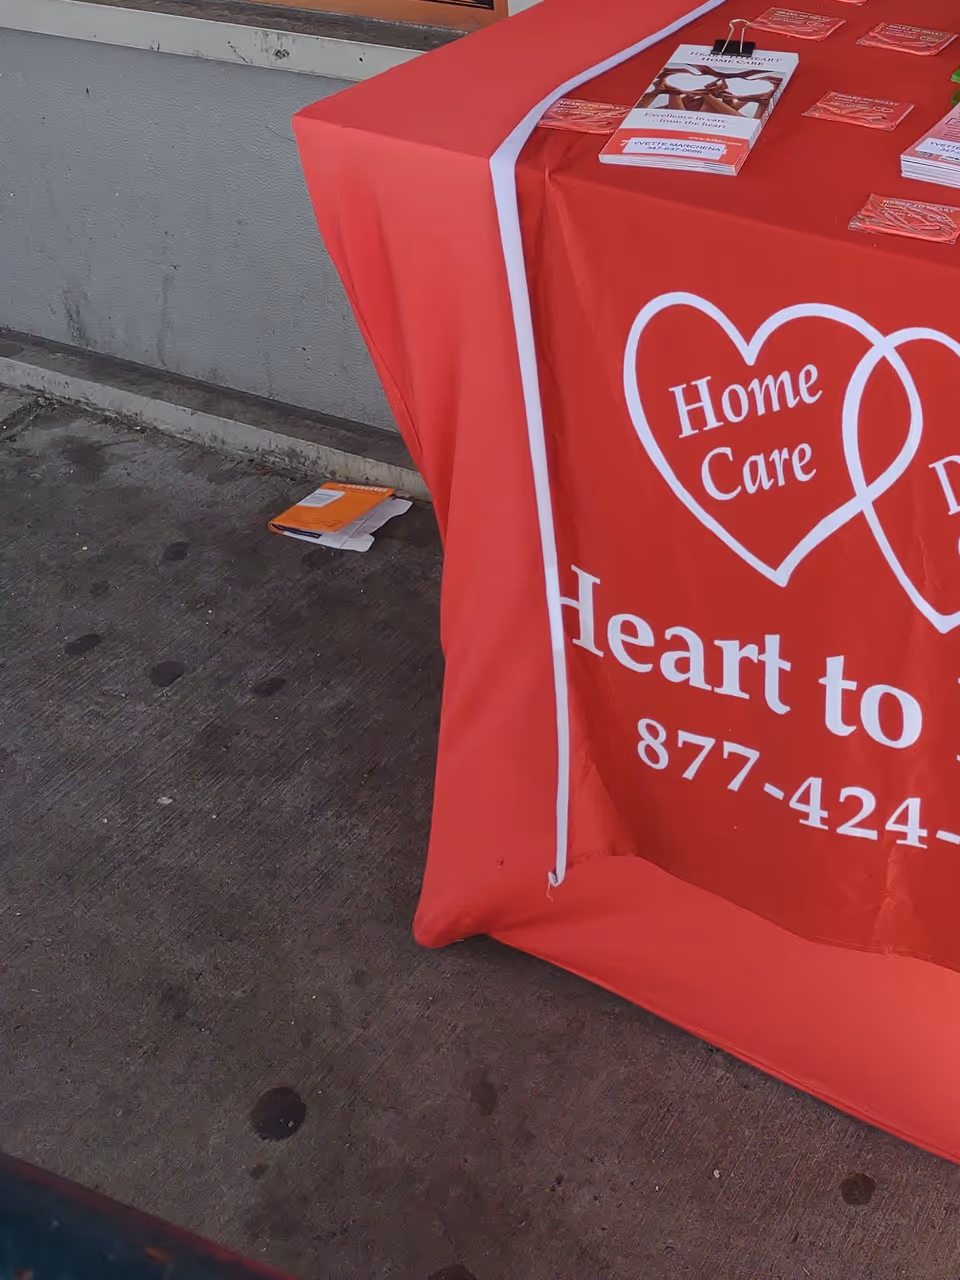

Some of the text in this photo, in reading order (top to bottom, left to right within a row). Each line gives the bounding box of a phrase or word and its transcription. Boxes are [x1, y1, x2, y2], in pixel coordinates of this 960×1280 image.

[632, 140, 668, 148] YVETTE
[668, 143, 721, 152] MARCHENA
[668, 362, 824, 439] Home
[699, 441, 817, 502] Care
[559, 564, 792, 715] Heart
[818, 655, 923, 749] to
